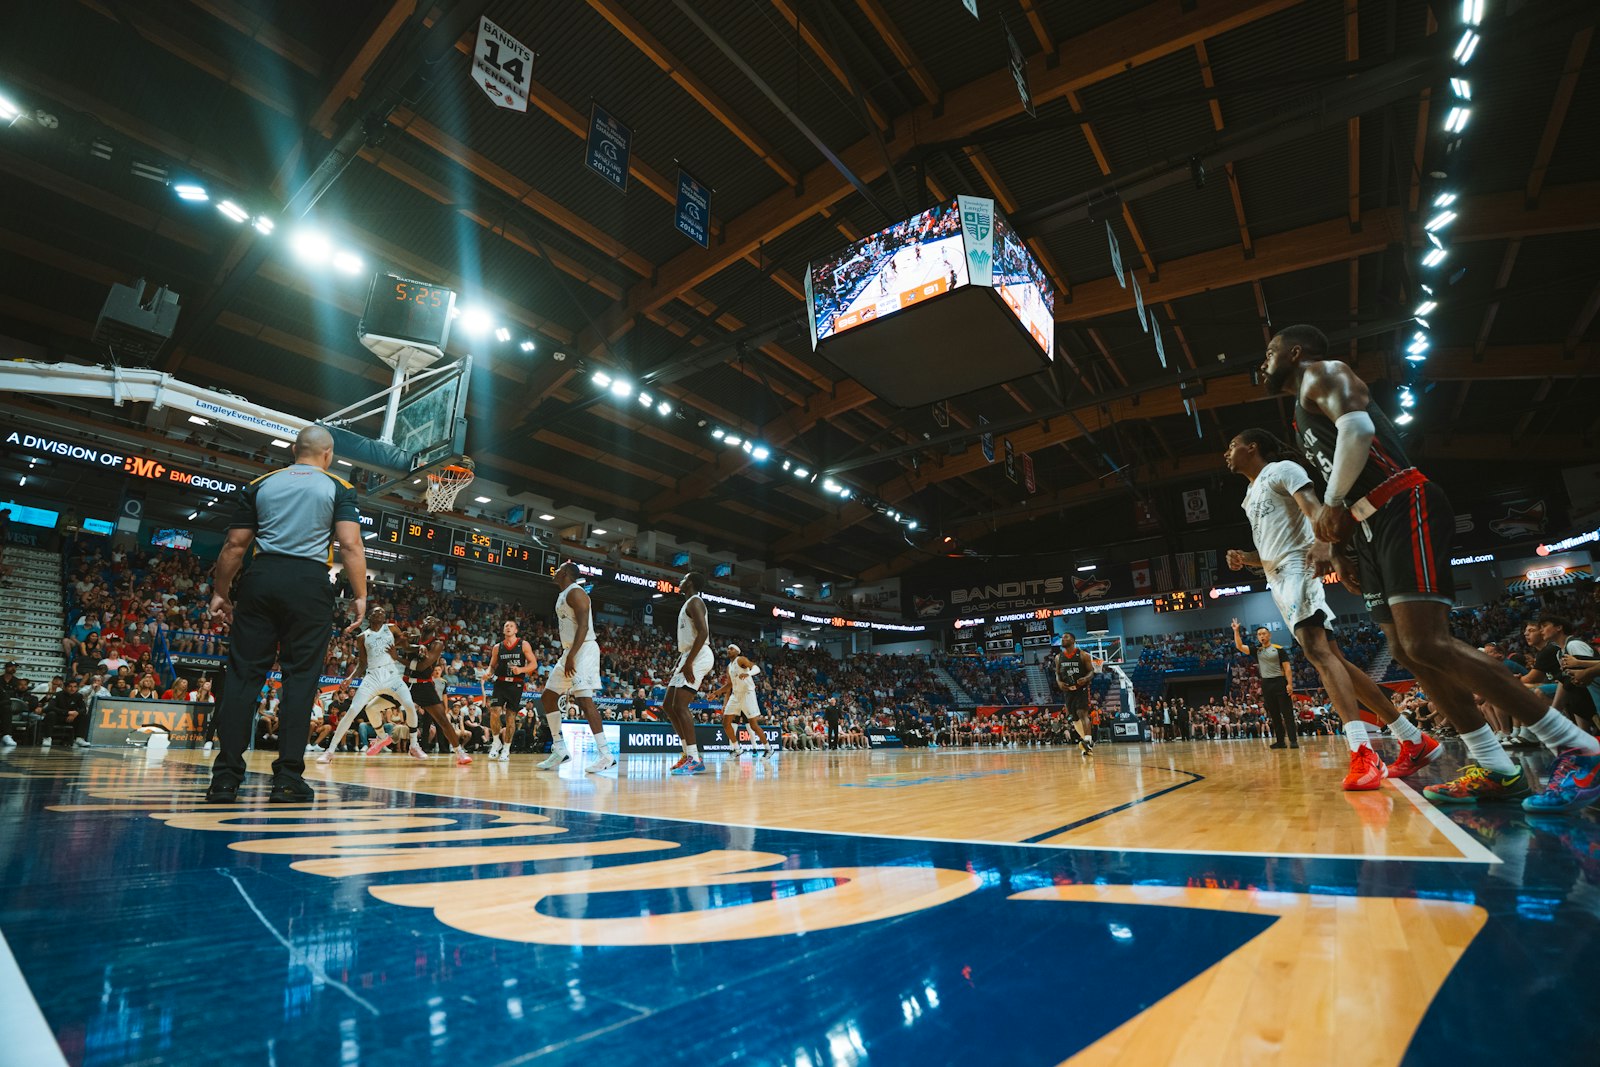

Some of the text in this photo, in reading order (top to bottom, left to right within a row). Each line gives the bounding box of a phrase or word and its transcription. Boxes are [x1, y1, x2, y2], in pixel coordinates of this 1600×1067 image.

[484, 22, 530, 61] BANDITS
[484, 39, 524, 84] 14
[477, 60, 526, 98] KENDALL
[593, 160, 620, 183] 2017-18
[680, 221, 703, 241] 2018-19
[396, 276, 432, 287] DAKTRONICS
[396, 284, 442, 307] 5:25
[196, 400, 299, 437] LangleyEventsCentre.co
[6, 431, 20, 445] A
[23, 434, 97, 462] DIVISION
[100, 453, 124, 467] OF
[169, 470, 237, 494] BMGROUP
[124, 500, 141, 518] Q
[390, 531, 398, 542] 3
[408, 524, 435, 540] 30 2
[472, 534, 491, 547] 5:25
[453, 545, 466, 557] 86
[488, 552, 500, 564] 81
[506, 548, 529, 561] 21 3
[614, 572, 620, 580] A
[620, 574, 648, 587] DIVISION
[648, 580, 658, 588] OF
[950, 576, 1064, 604] BANDITS
[962, 598, 1054, 614] BASKETBALL
[1000, 613, 1025, 622] DIVISION
[1085, 599, 1152, 612] bmgroupinternational.co
[98, 708, 205, 732] LiUNA!
[189, 734, 204, 742] the
[628, 734, 664, 746] NORTH
